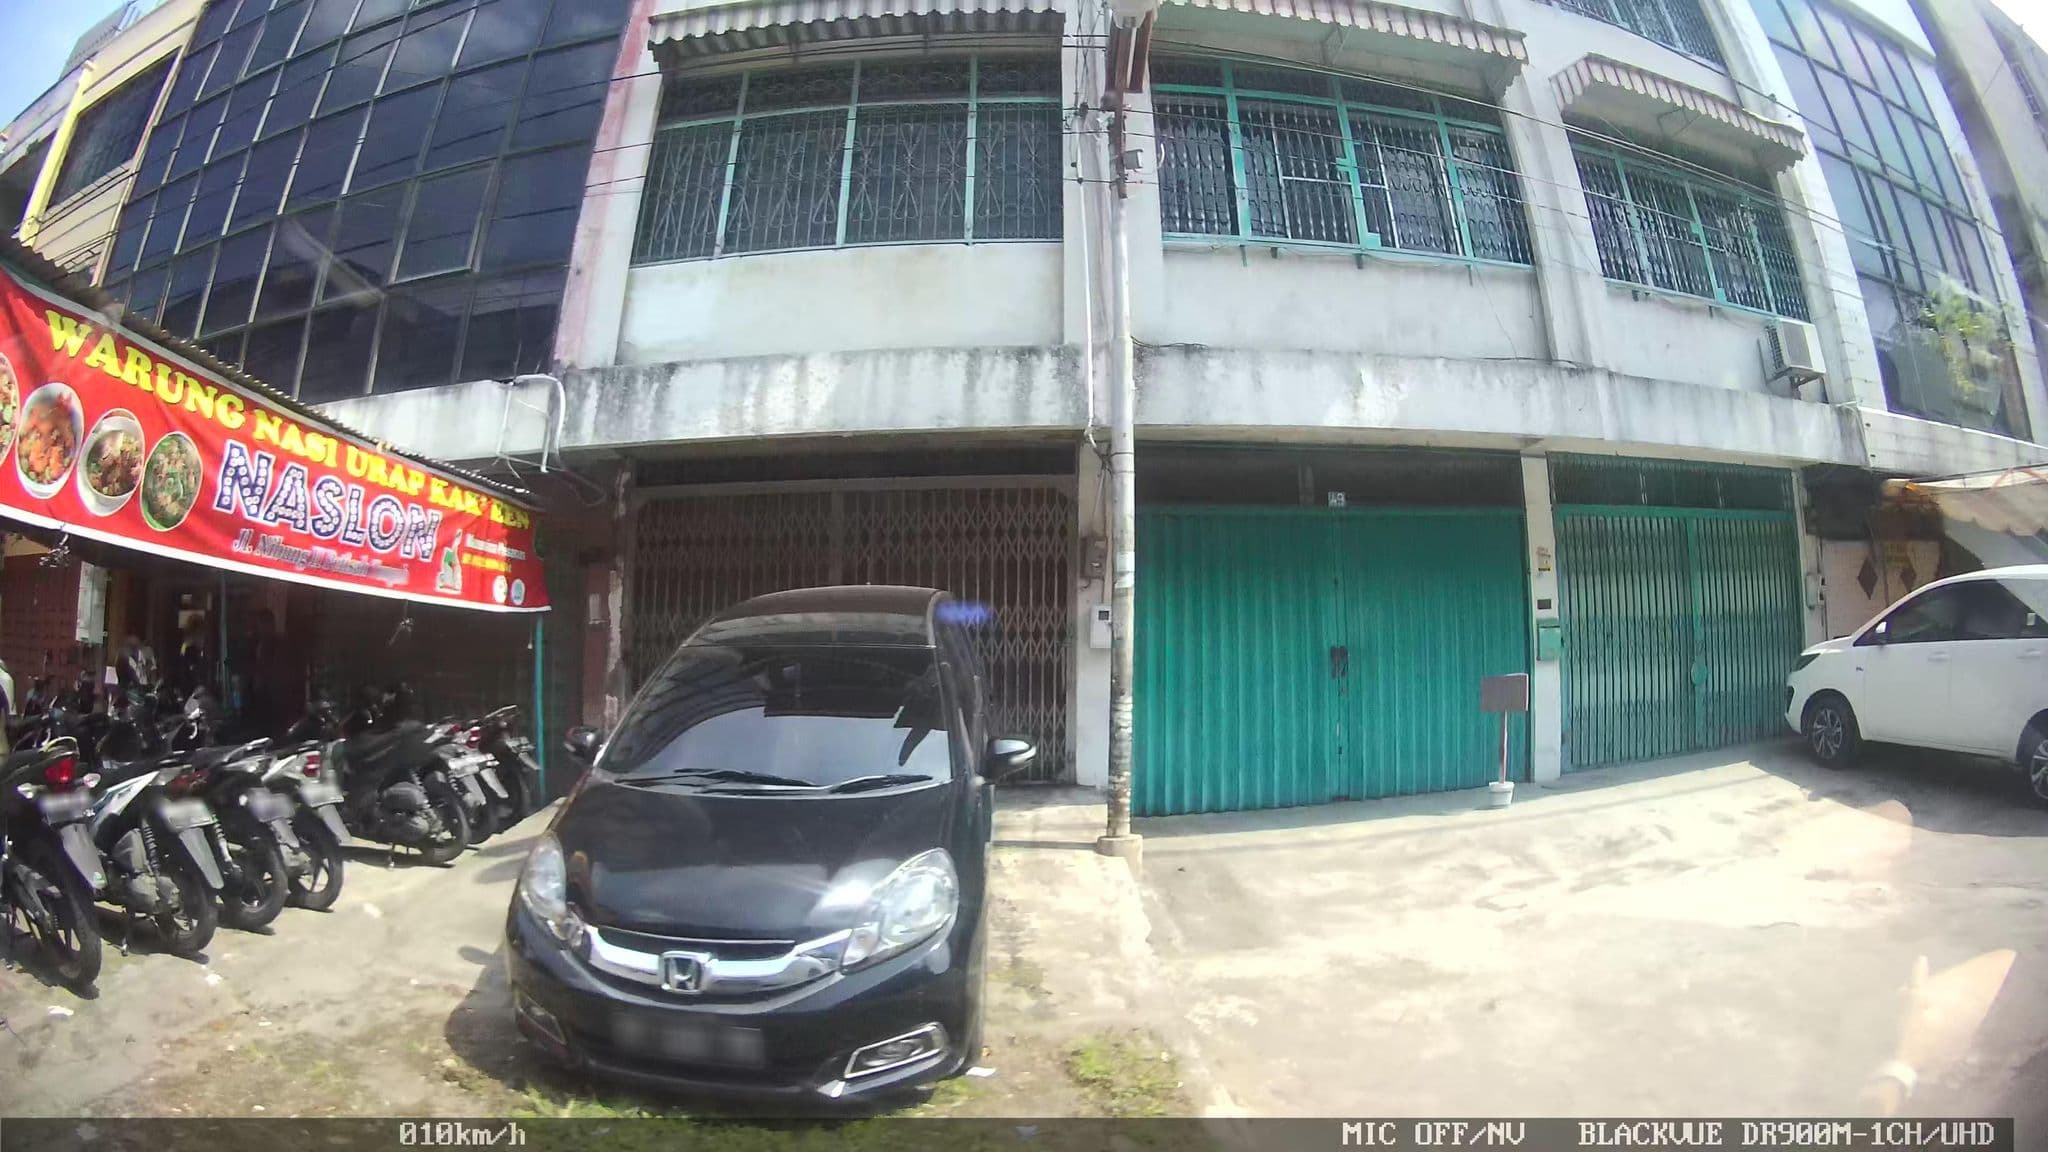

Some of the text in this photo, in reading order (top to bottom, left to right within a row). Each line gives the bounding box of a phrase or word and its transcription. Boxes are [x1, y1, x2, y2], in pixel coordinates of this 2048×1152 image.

[46, 310, 246, 429] WARUNG
[252, 409, 338, 468] NASI
[345, 444, 426, 497] URAP
[214, 439, 442, 562] NASLON
